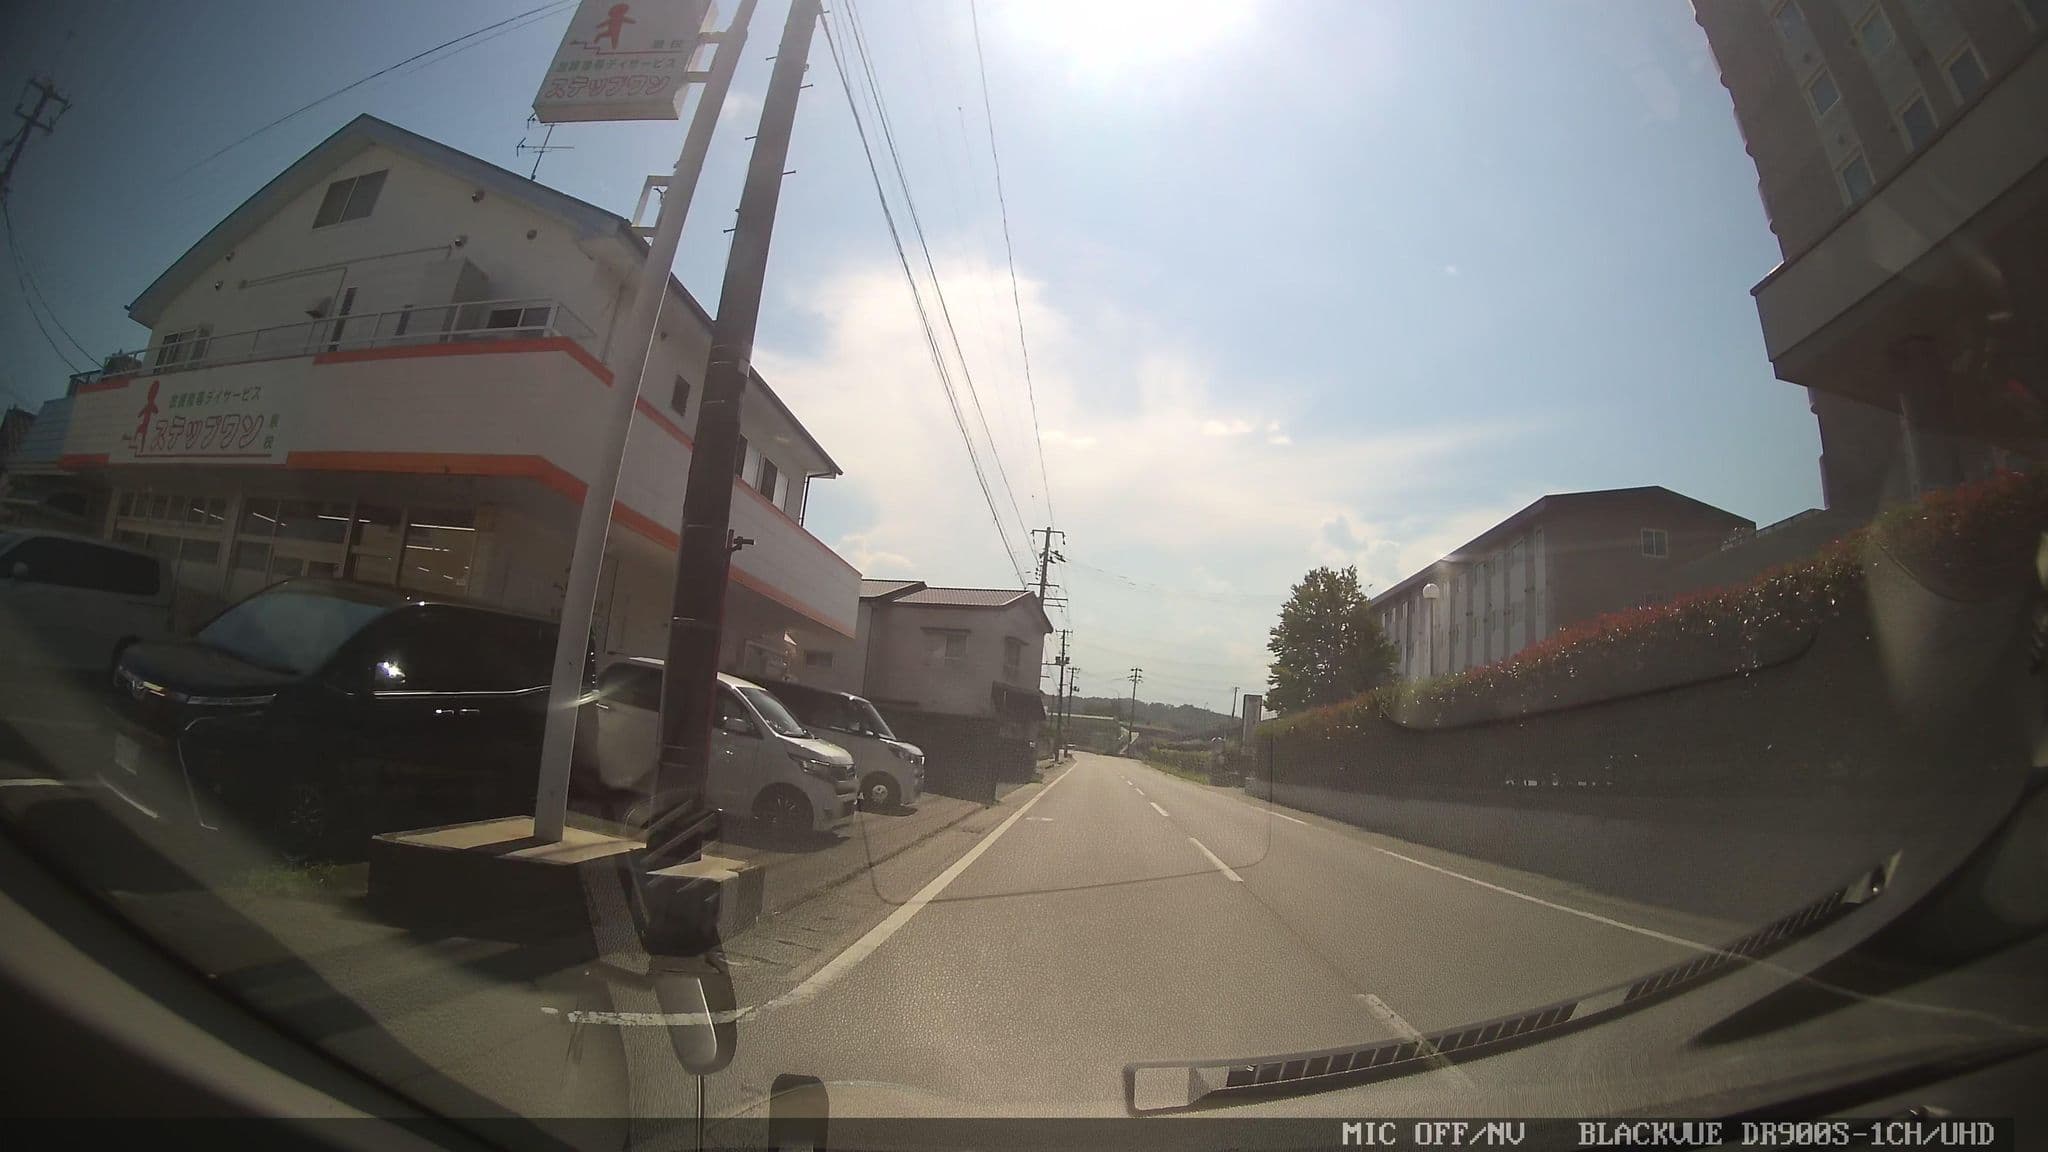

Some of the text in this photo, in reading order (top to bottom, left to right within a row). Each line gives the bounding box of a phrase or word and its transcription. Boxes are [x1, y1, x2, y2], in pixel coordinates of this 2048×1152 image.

[546, 75, 670, 97] ステップワン
[153, 414, 264, 450] ステップワン
